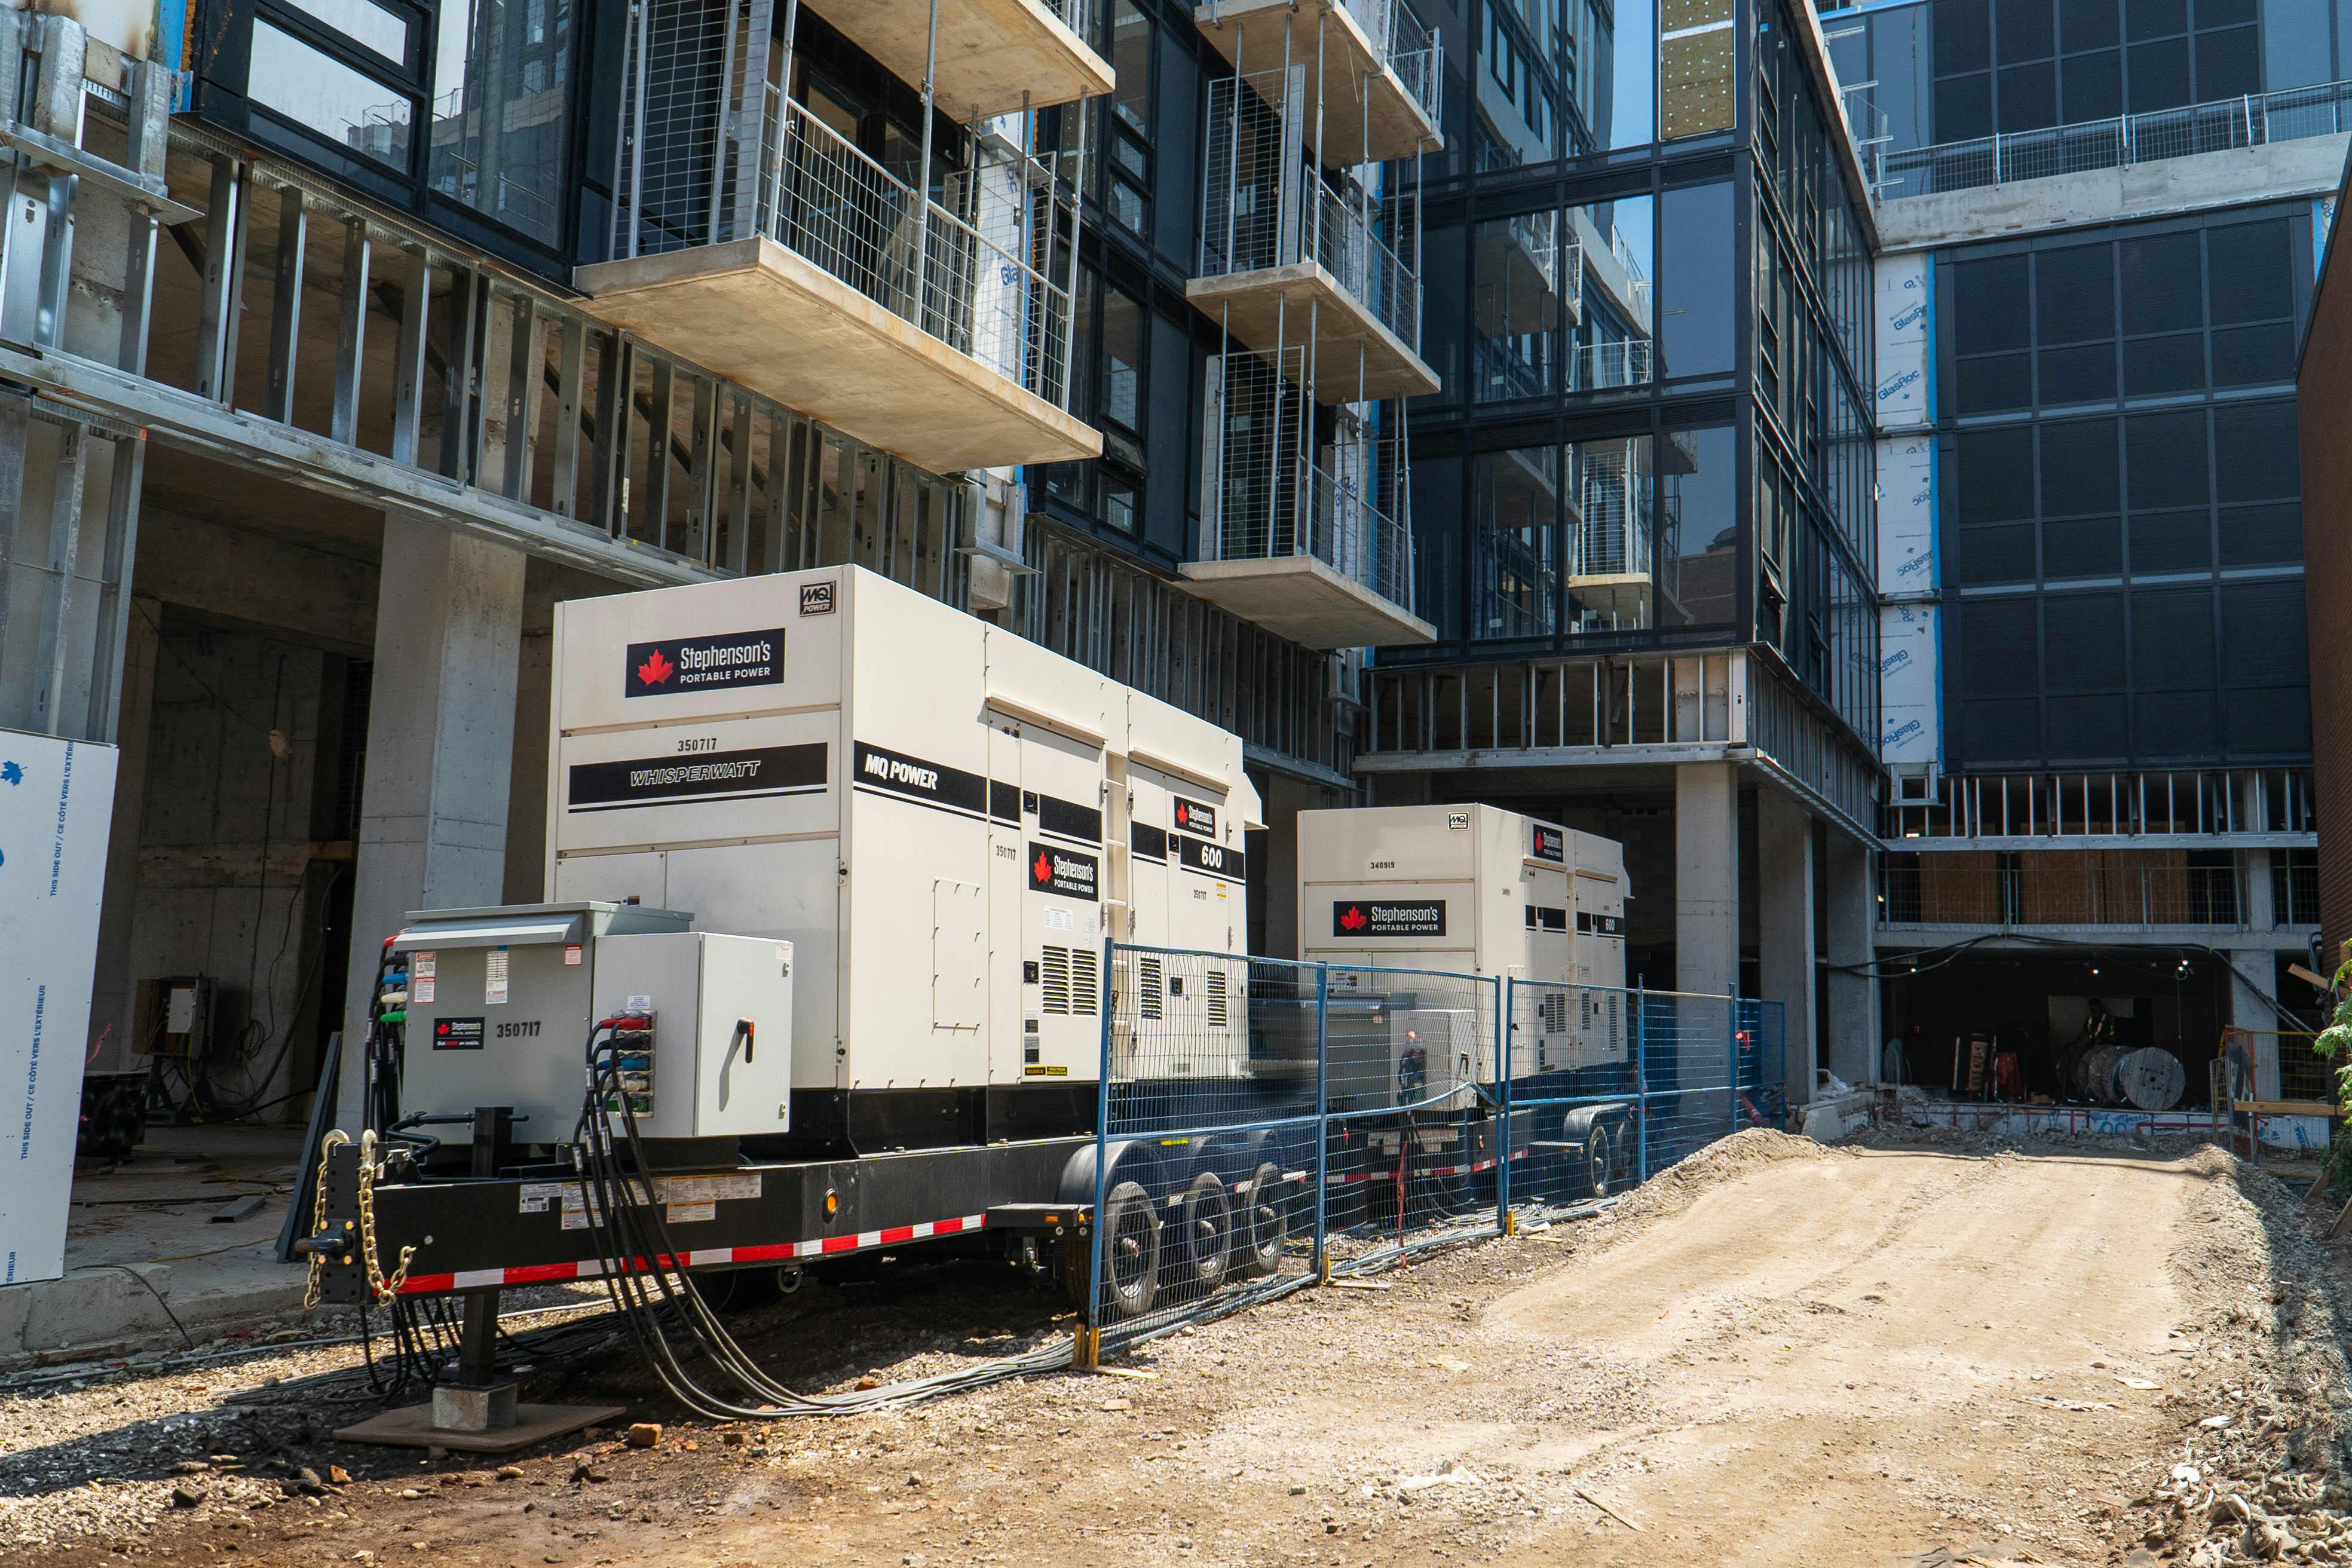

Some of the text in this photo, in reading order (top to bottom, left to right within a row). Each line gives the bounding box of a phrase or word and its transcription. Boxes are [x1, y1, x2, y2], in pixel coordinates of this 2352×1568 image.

[1001, 263, 1018, 286] Gla
[1878, 370, 1919, 400] GlasRoc
[803, 587, 830, 602] MQ
[804, 604, 829, 612] POWER
[681, 640, 770, 670] Stephenson's
[680, 667, 770, 684] PORTABLE POWER
[677, 738, 718, 752] 350717
[630, 760, 761, 786] WHISPERWATT
[865, 754, 938, 790] MQ POWER
[59, 801, 67, 822] CÔTÉ
[1188, 805, 1212, 825] Stephenson's
[58, 823, 64, 834] CE
[996, 844, 1016, 861] 350717
[1201, 845, 1222, 868] 600
[1054, 855, 1094, 882] Stephenson's
[1370, 861, 1395, 869] 340919
[1054, 880, 1094, 894] PORTABLE POWER
[1372, 906, 1438, 923] Stephenson's
[1605, 918, 1615, 930] 600
[35, 984, 47, 1036] L'EXTÉRIEUR
[497, 1021, 541, 1038] 350717
[32, 1037, 40, 1059] VERS
[29, 1060, 38, 1082] CÔTÉ
[29, 1083, 35, 1095] CE
